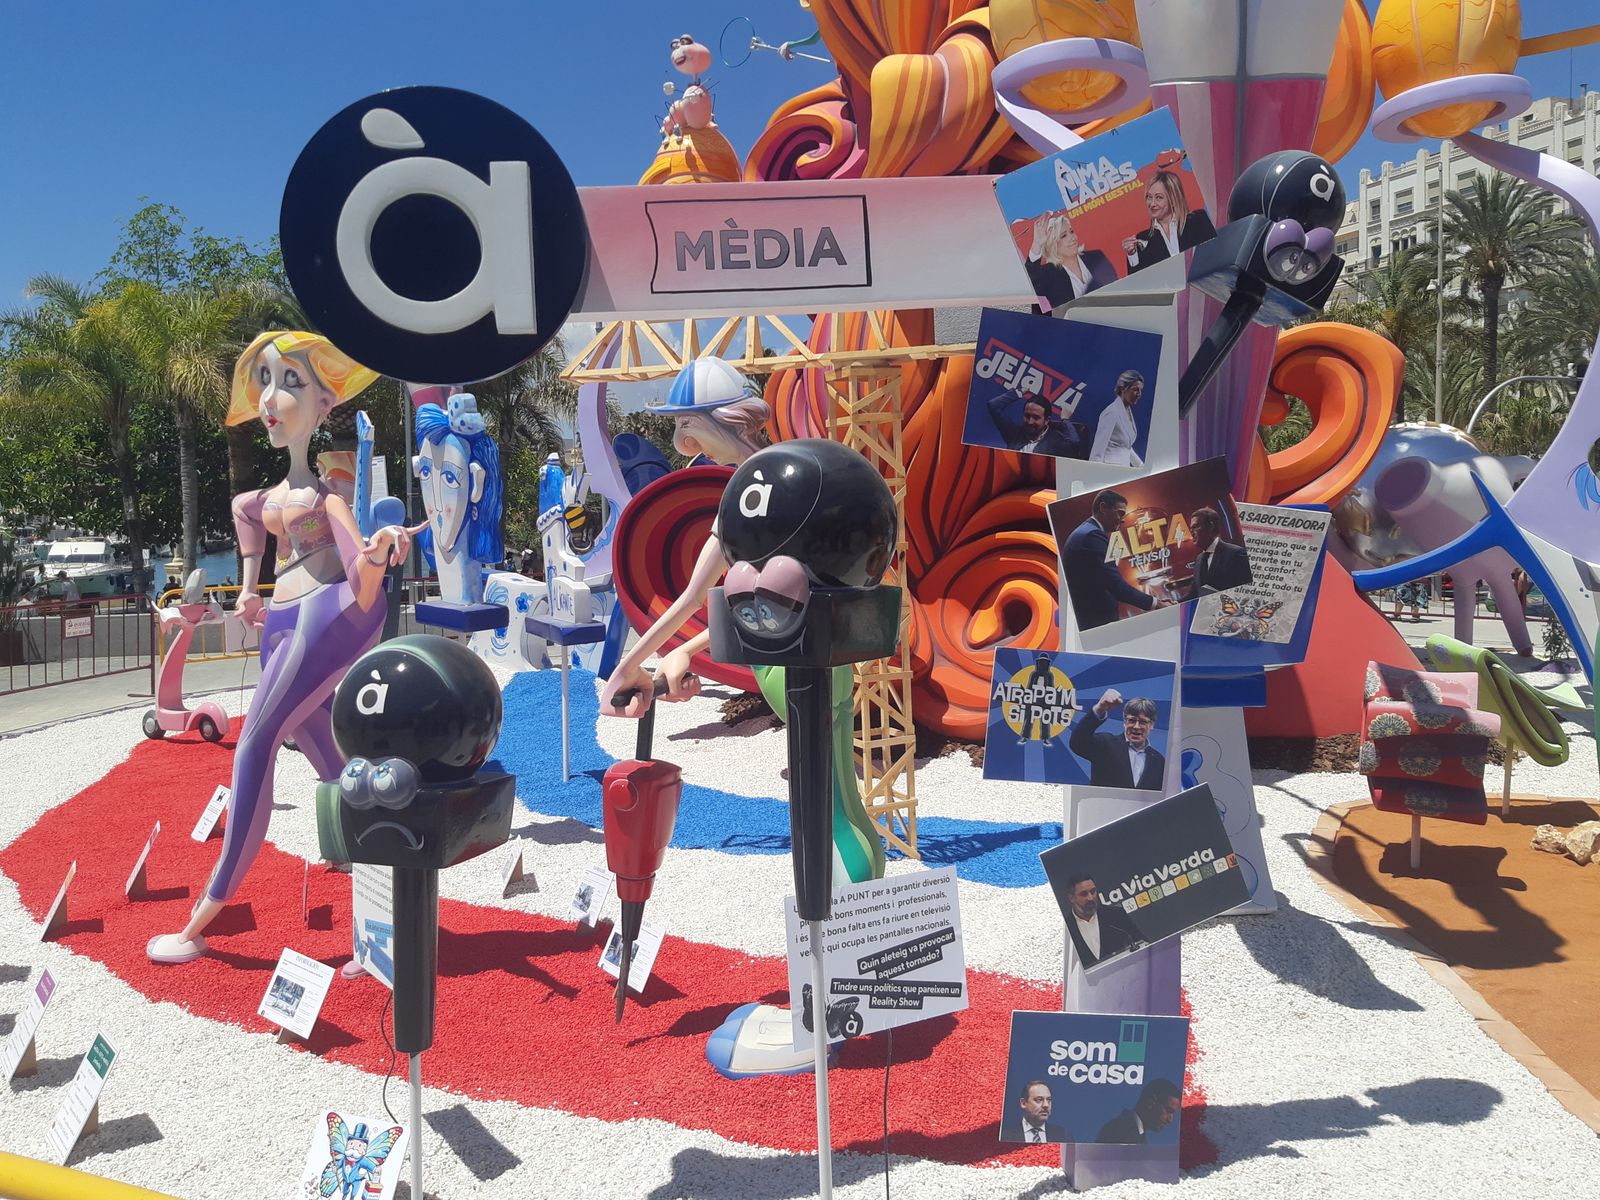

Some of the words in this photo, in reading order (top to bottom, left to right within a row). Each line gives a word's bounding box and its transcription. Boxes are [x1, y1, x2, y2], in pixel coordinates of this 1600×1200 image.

[1068, 207, 1084, 219] UN
[1105, 179, 1144, 202] BESTIAL
[336, 107, 538, 335] à
[674, 217, 848, 272] MÈDIA
[1246, 512, 1326, 532] SABOTEADORA
[1103, 512, 1194, 564] ALTA
[1246, 537, 1288, 549] arquetipo
[1290, 542, 1307, 551] que
[1281, 550, 1293, 558] de
[1251, 562, 1262, 571] de
[1234, 586, 1276, 598] alrededor
[1258, 581, 1270, 589] de
[1272, 583, 1292, 592] todo
[1293, 585, 1303, 593] tu
[1098, 887, 1123, 906] La
[1121, 875, 1156, 896] Via
[1154, 847, 1215, 881] Verda
[839, 896, 846, 904] A
[847, 890, 870, 902] PUNT
[871, 889, 885, 900] per
[892, 880, 921, 896] garantir
[922, 874, 951, 888] diversió
[827, 927, 847, 937] bona
[848, 922, 867, 932] falta
[867, 919, 881, 928] ens
[882, 916, 890, 925] fa
[891, 914, 909, 923] riure
[910, 911, 920, 919] en
[921, 902, 951, 917] televisió
[835, 910, 854, 920] bons
[855, 902, 891, 916] moments
[892, 900, 895, 908] i
[827, 941, 840, 954] qui
[841, 937, 866, 948] ocupa
[867, 934, 878, 943] les
[880, 926, 914, 942] pantalles
[915, 918, 952, 933] nacionals.
[859, 959, 880, 971] Quin
[880, 948, 908, 964] aleteig
[908, 945, 918, 954] va
[918, 932, 953, 952] provocar
[878, 962, 906, 979] aquest
[906, 949, 940, 968] tornado?
[833, 981, 859, 991] Tindre
[859, 984, 873, 992] uns
[874, 983, 902, 994] polítics
[902, 986, 917, 995] que
[918, 985, 950, 995] pareixen
[871, 996, 898, 1008] Reality
[898, 997, 920, 1007] Show
[1050, 1039, 1117, 1062] som
[1047, 1062, 1069, 1076] de
[1069, 1063, 1145, 1085] casa
